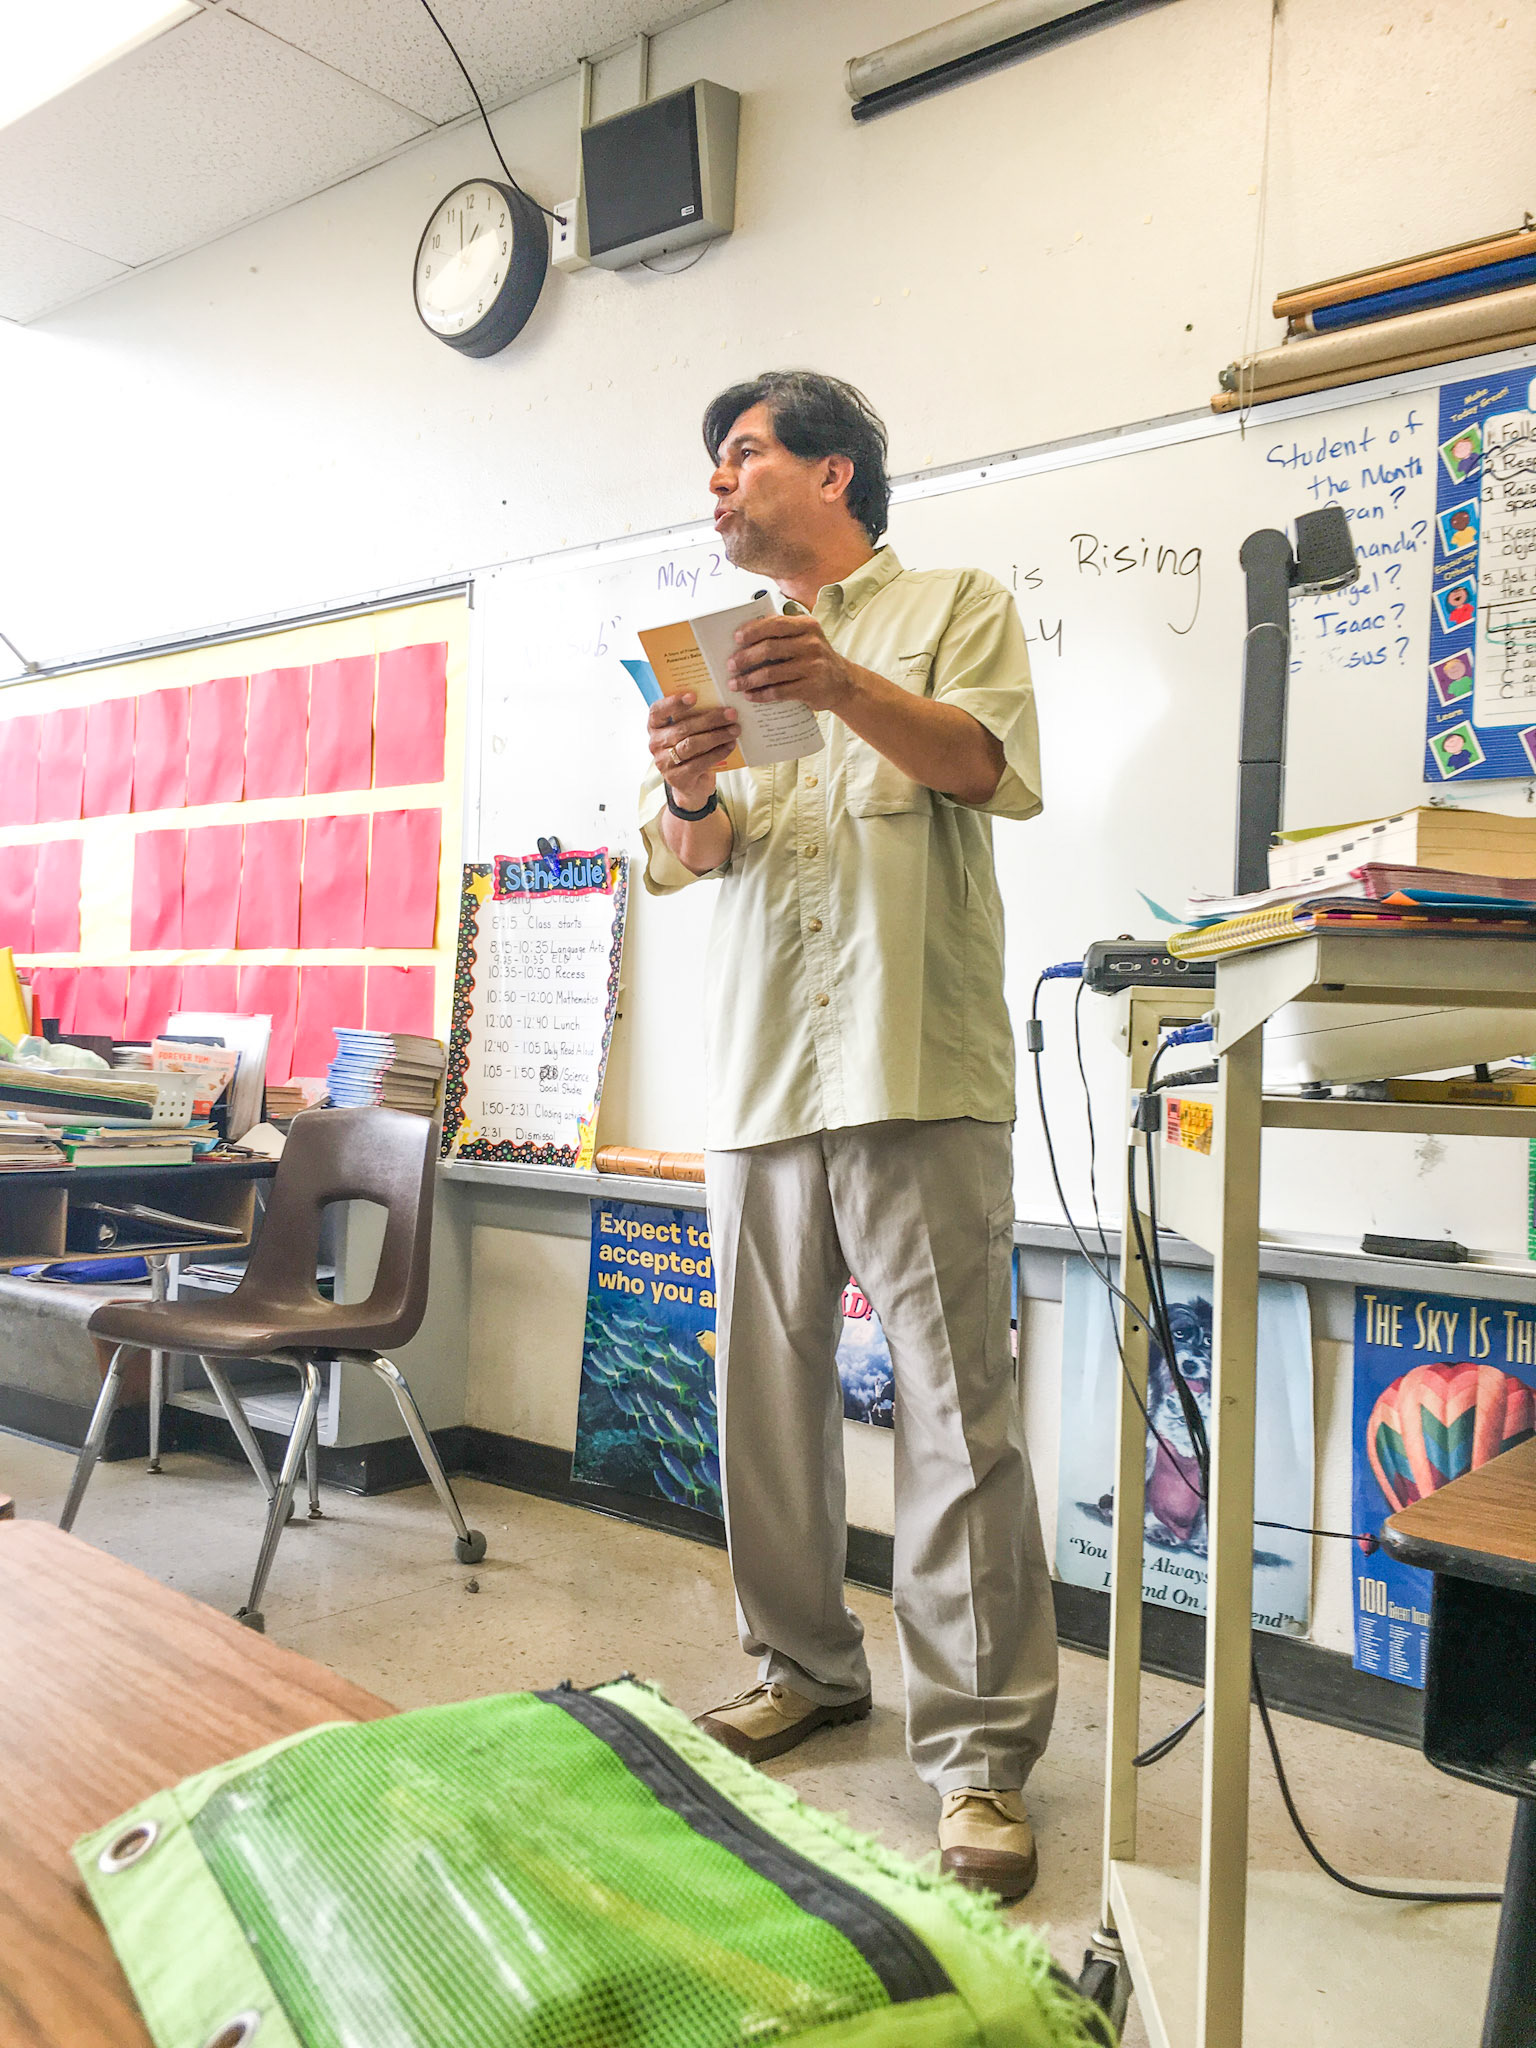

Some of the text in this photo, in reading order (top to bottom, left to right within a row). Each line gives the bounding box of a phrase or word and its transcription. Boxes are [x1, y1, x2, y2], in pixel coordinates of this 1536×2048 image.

[465, 194, 475, 210] 12
[447, 208, 456, 224] 11
[499, 212, 506, 228] 2
[431, 234, 441, 250] 10
[502, 241, 508, 256] 3
[492, 272, 500, 287] 4
[476, 300, 484, 315] 5
[1266, 409, 1424, 470] Student of
[1306, 456, 1424, 501] the Month
[657, 561, 701, 598] May
[1012, 533, 1203, 635] is Rising
[506, 859, 604, 891] Schedule
[527, 915, 552, 929] Class
[557, 915, 583, 929] starts
[550, 940, 587, 960] Language
[588, 940, 606, 953] Arts
[555, 965, 586, 979] Recess
[556, 990, 600, 1005] Mathematics
[553, 1017, 580, 1031] Lunch
[534, 1102, 563, 1125] Closing
[515, 1127, 556, 1141] Dismissal
[600, 1211, 711, 1249] Expect to
[598, 1243, 712, 1279] accepted
[597, 1270, 646, 1295] who
[650, 1281, 694, 1305] you
[1362, 1294, 1536, 1367] THE SKY IS TH
[1172, 1588, 1200, 1609] On
[1357, 1576, 1388, 1617] 100
